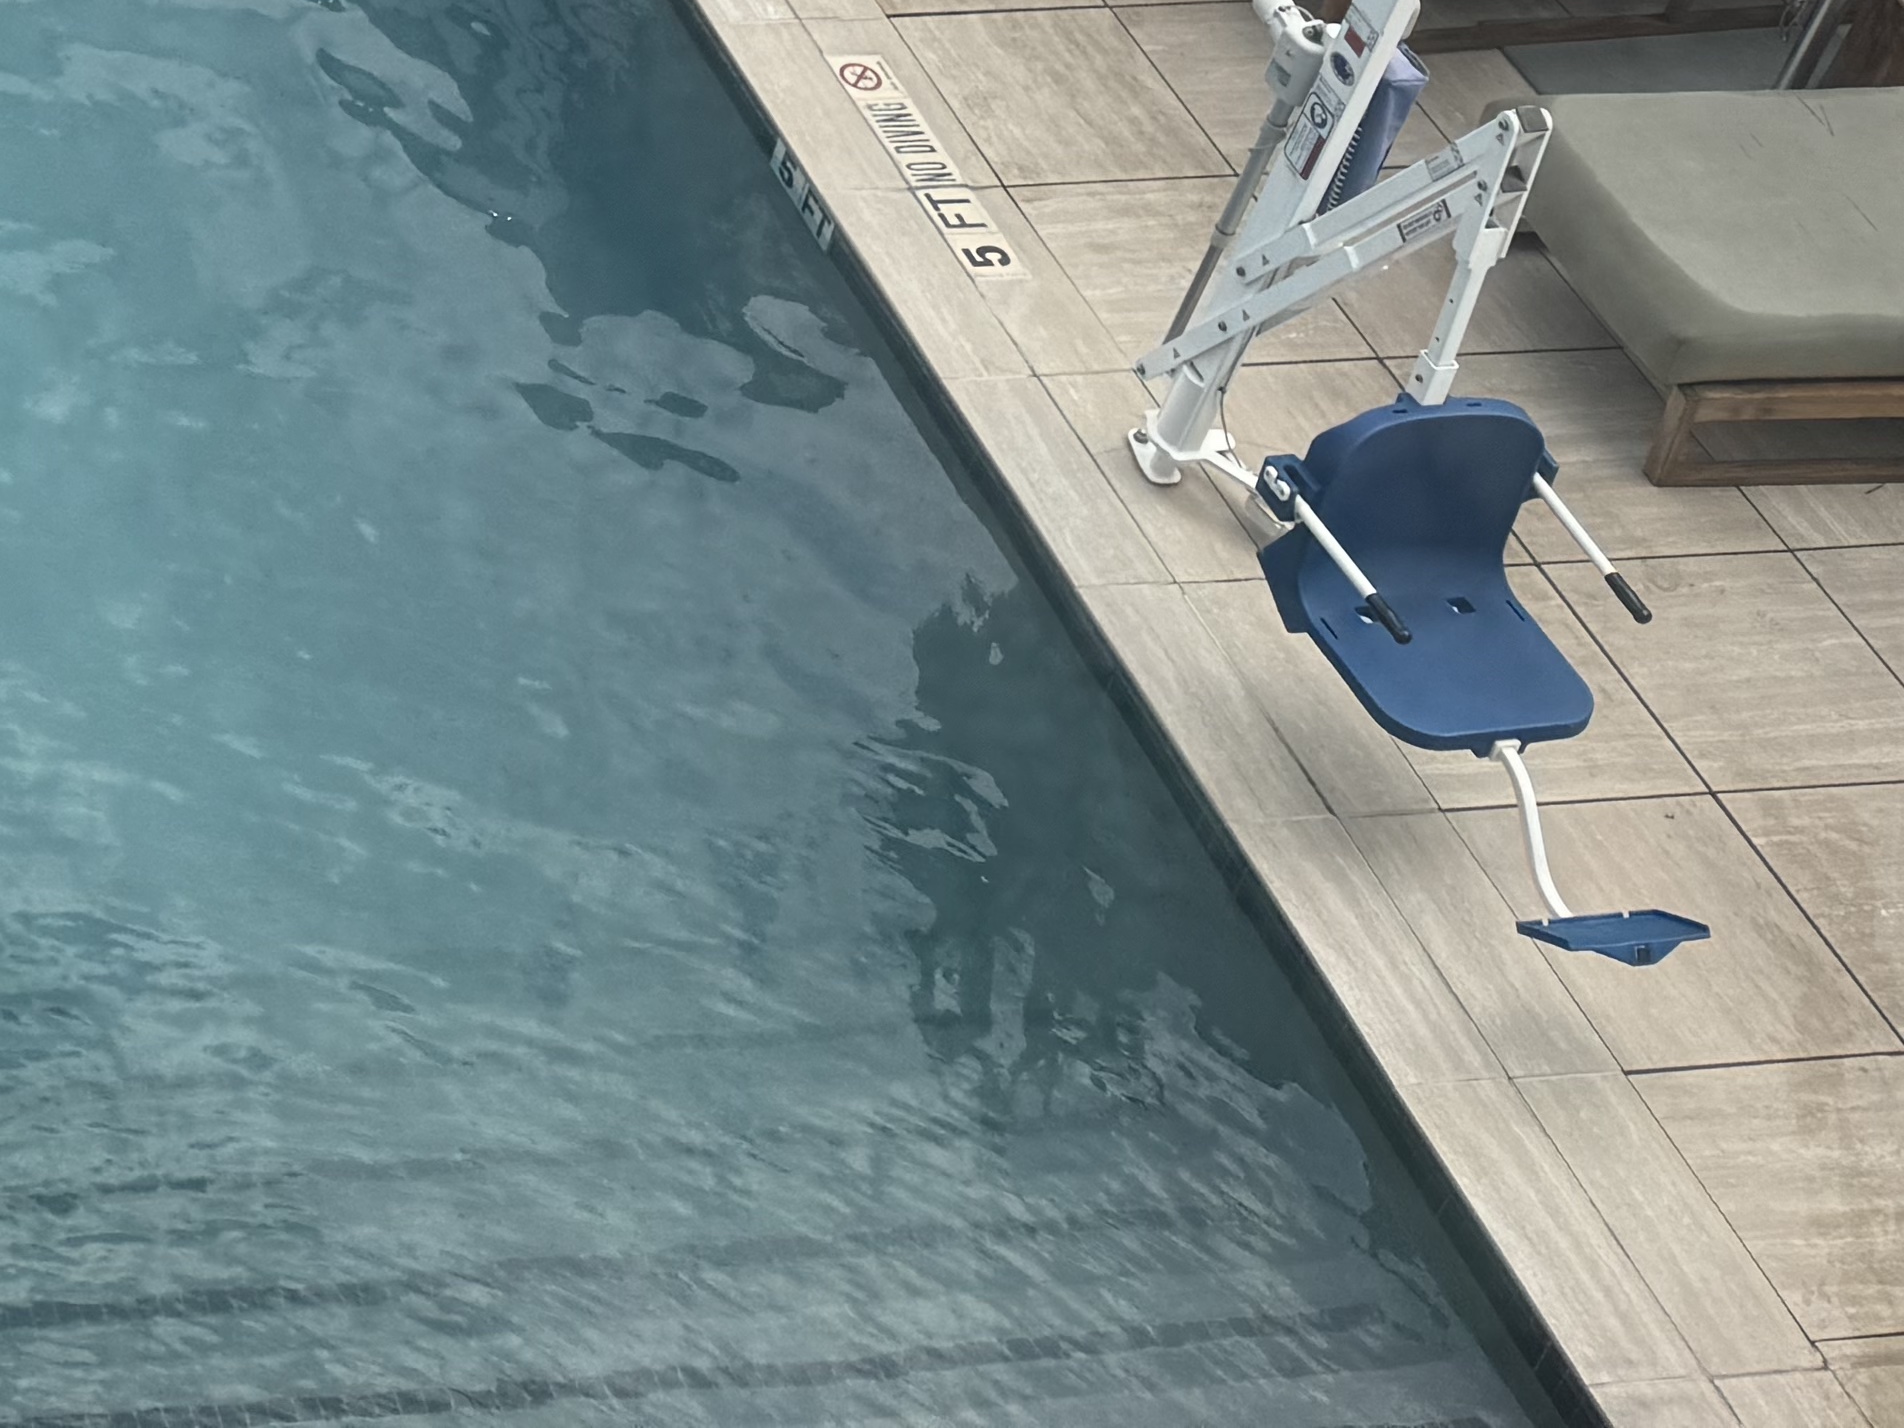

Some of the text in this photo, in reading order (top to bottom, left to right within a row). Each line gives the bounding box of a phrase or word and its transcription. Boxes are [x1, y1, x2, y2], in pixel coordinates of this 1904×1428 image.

[866, 101, 938, 154] DIVING
[905, 161, 957, 183] NO
[778, 152, 833, 240] 5 FT
[924, 192, 988, 229] FT
[961, 244, 1011, 268] 5
